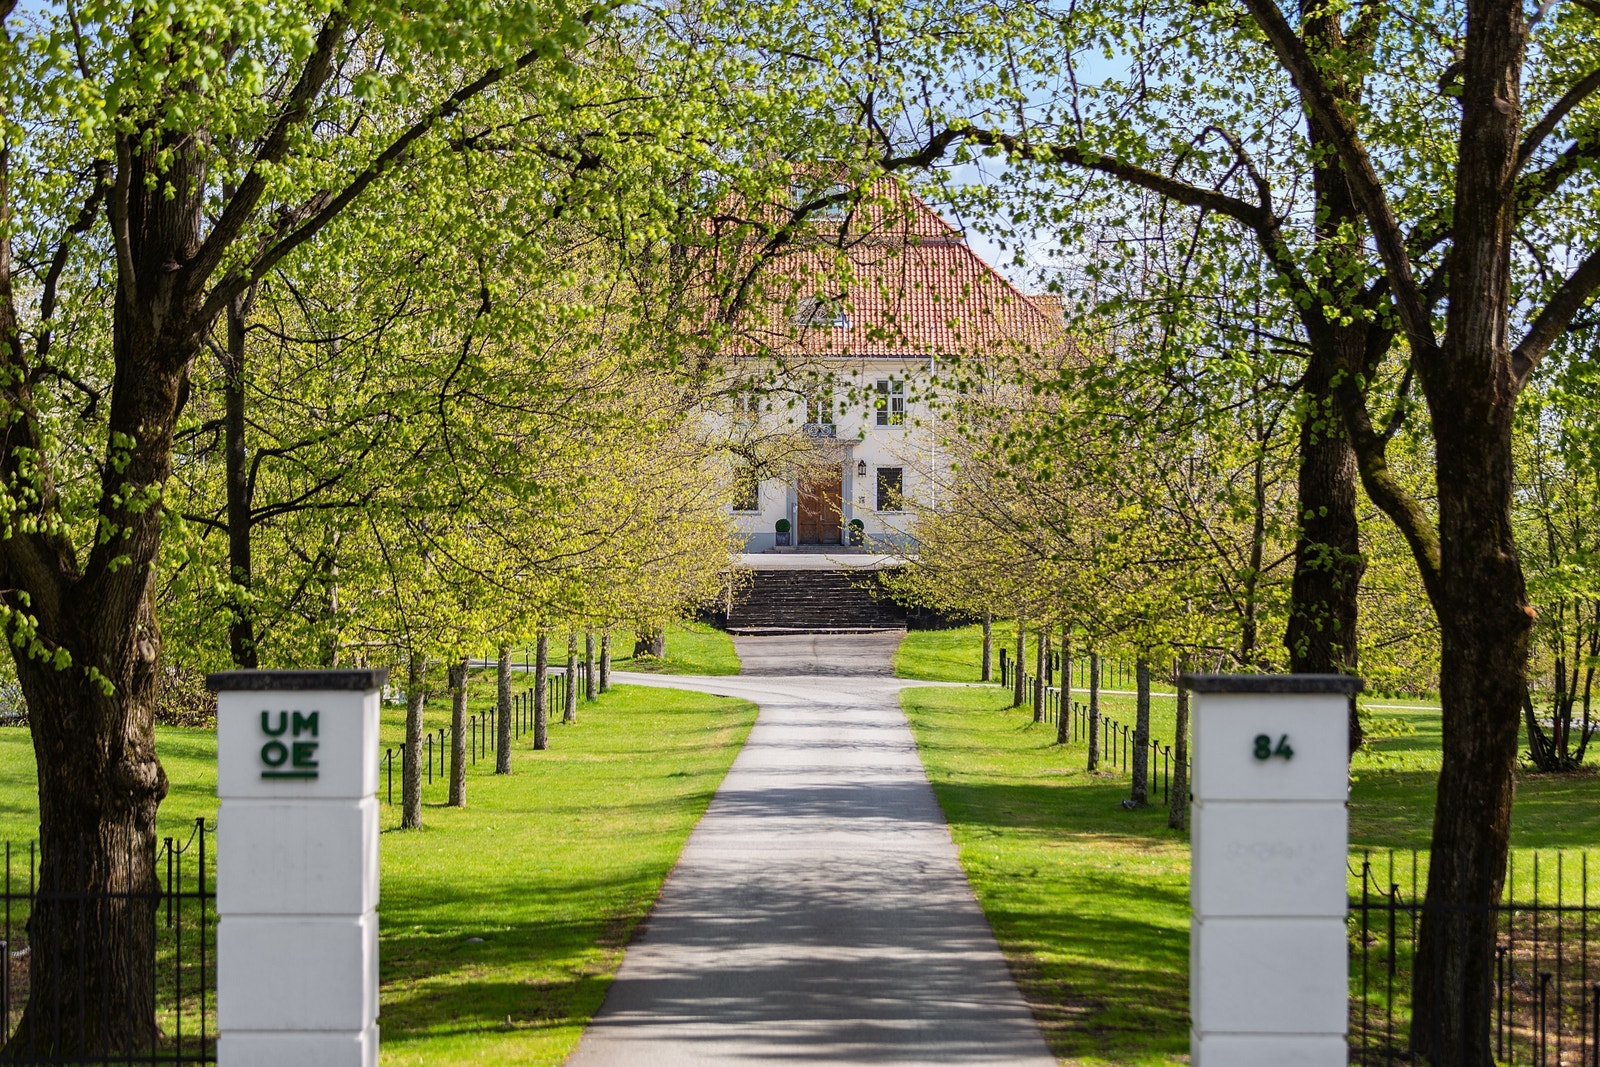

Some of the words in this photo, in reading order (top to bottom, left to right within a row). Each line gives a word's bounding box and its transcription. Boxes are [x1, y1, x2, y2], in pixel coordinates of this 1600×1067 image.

[261, 711, 319, 737] UM
[261, 741, 319, 768] OE
[1254, 734, 1294, 761] 84
